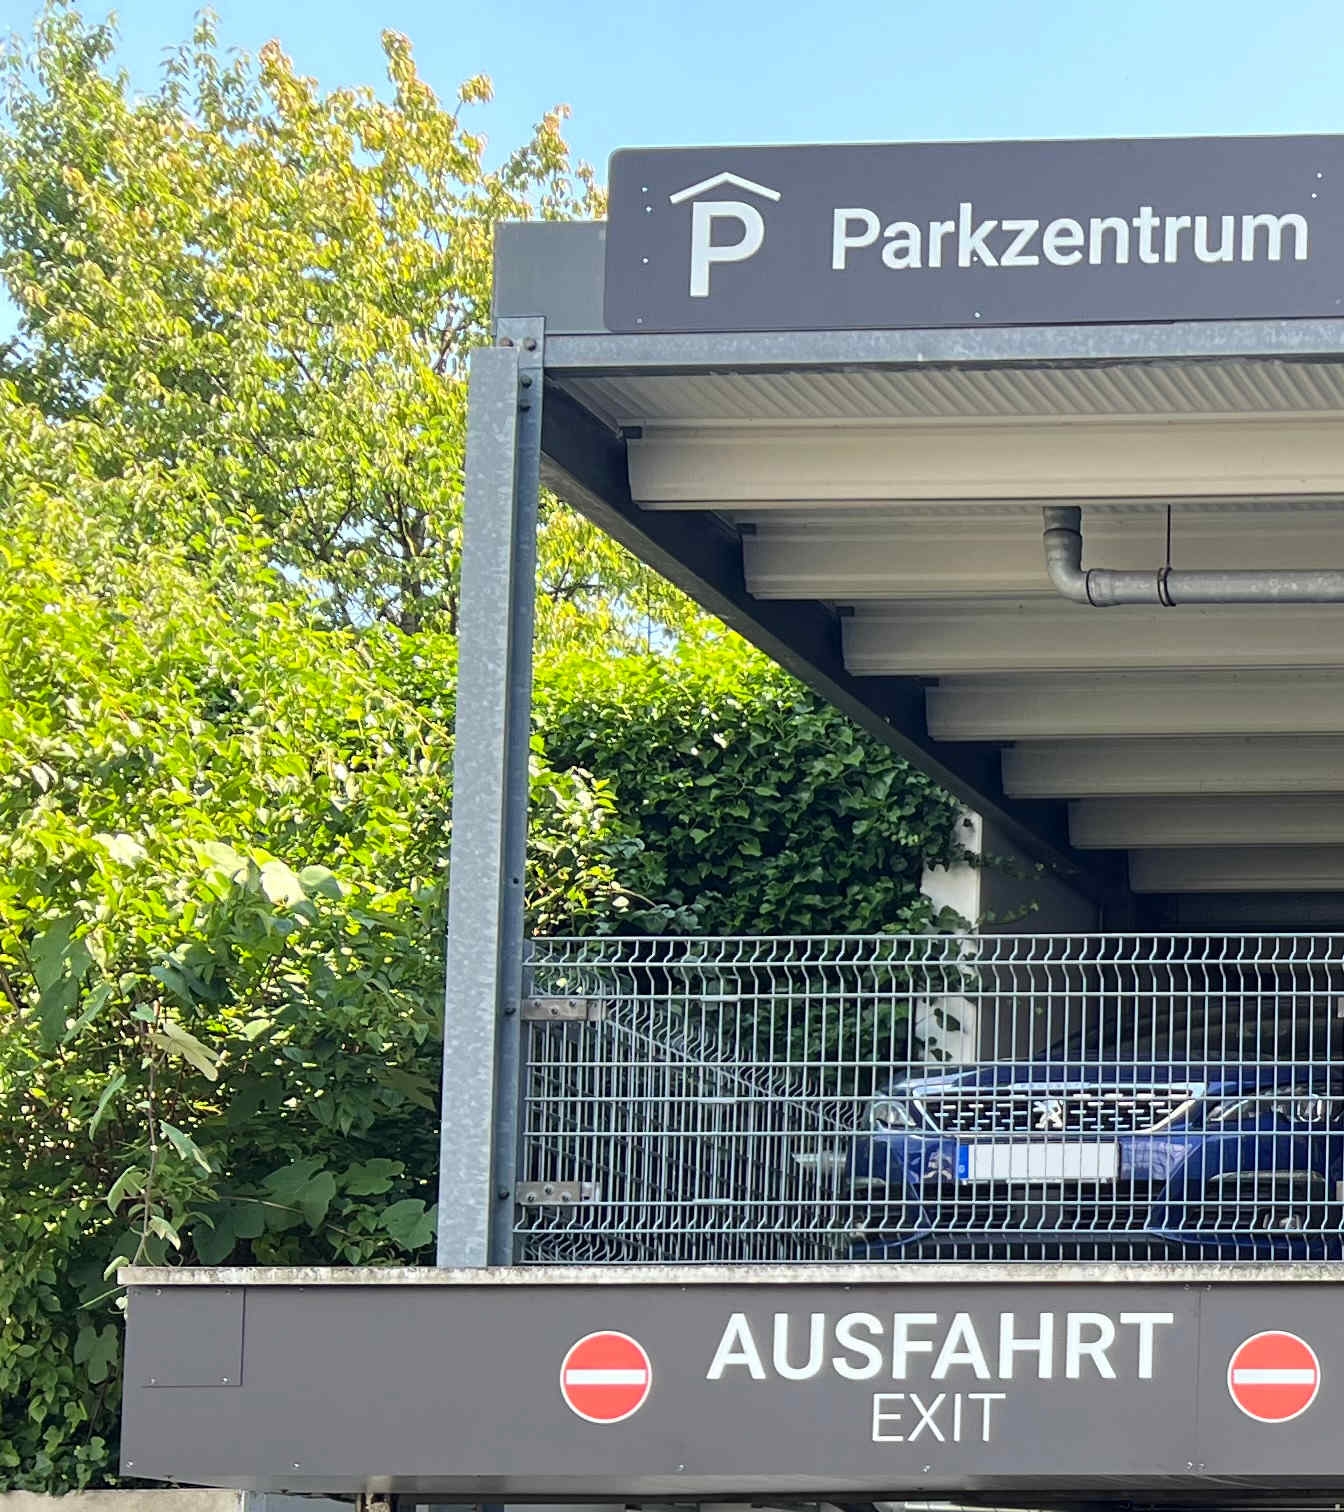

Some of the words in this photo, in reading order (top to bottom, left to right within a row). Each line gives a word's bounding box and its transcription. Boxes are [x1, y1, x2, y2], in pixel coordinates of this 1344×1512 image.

[690, 200, 766, 297] P
[831, 203, 1309, 271] Parkzentrum
[706, 1312, 1174, 1380] AUSFAHRT
[871, 1393, 1006, 1442] EXIT
